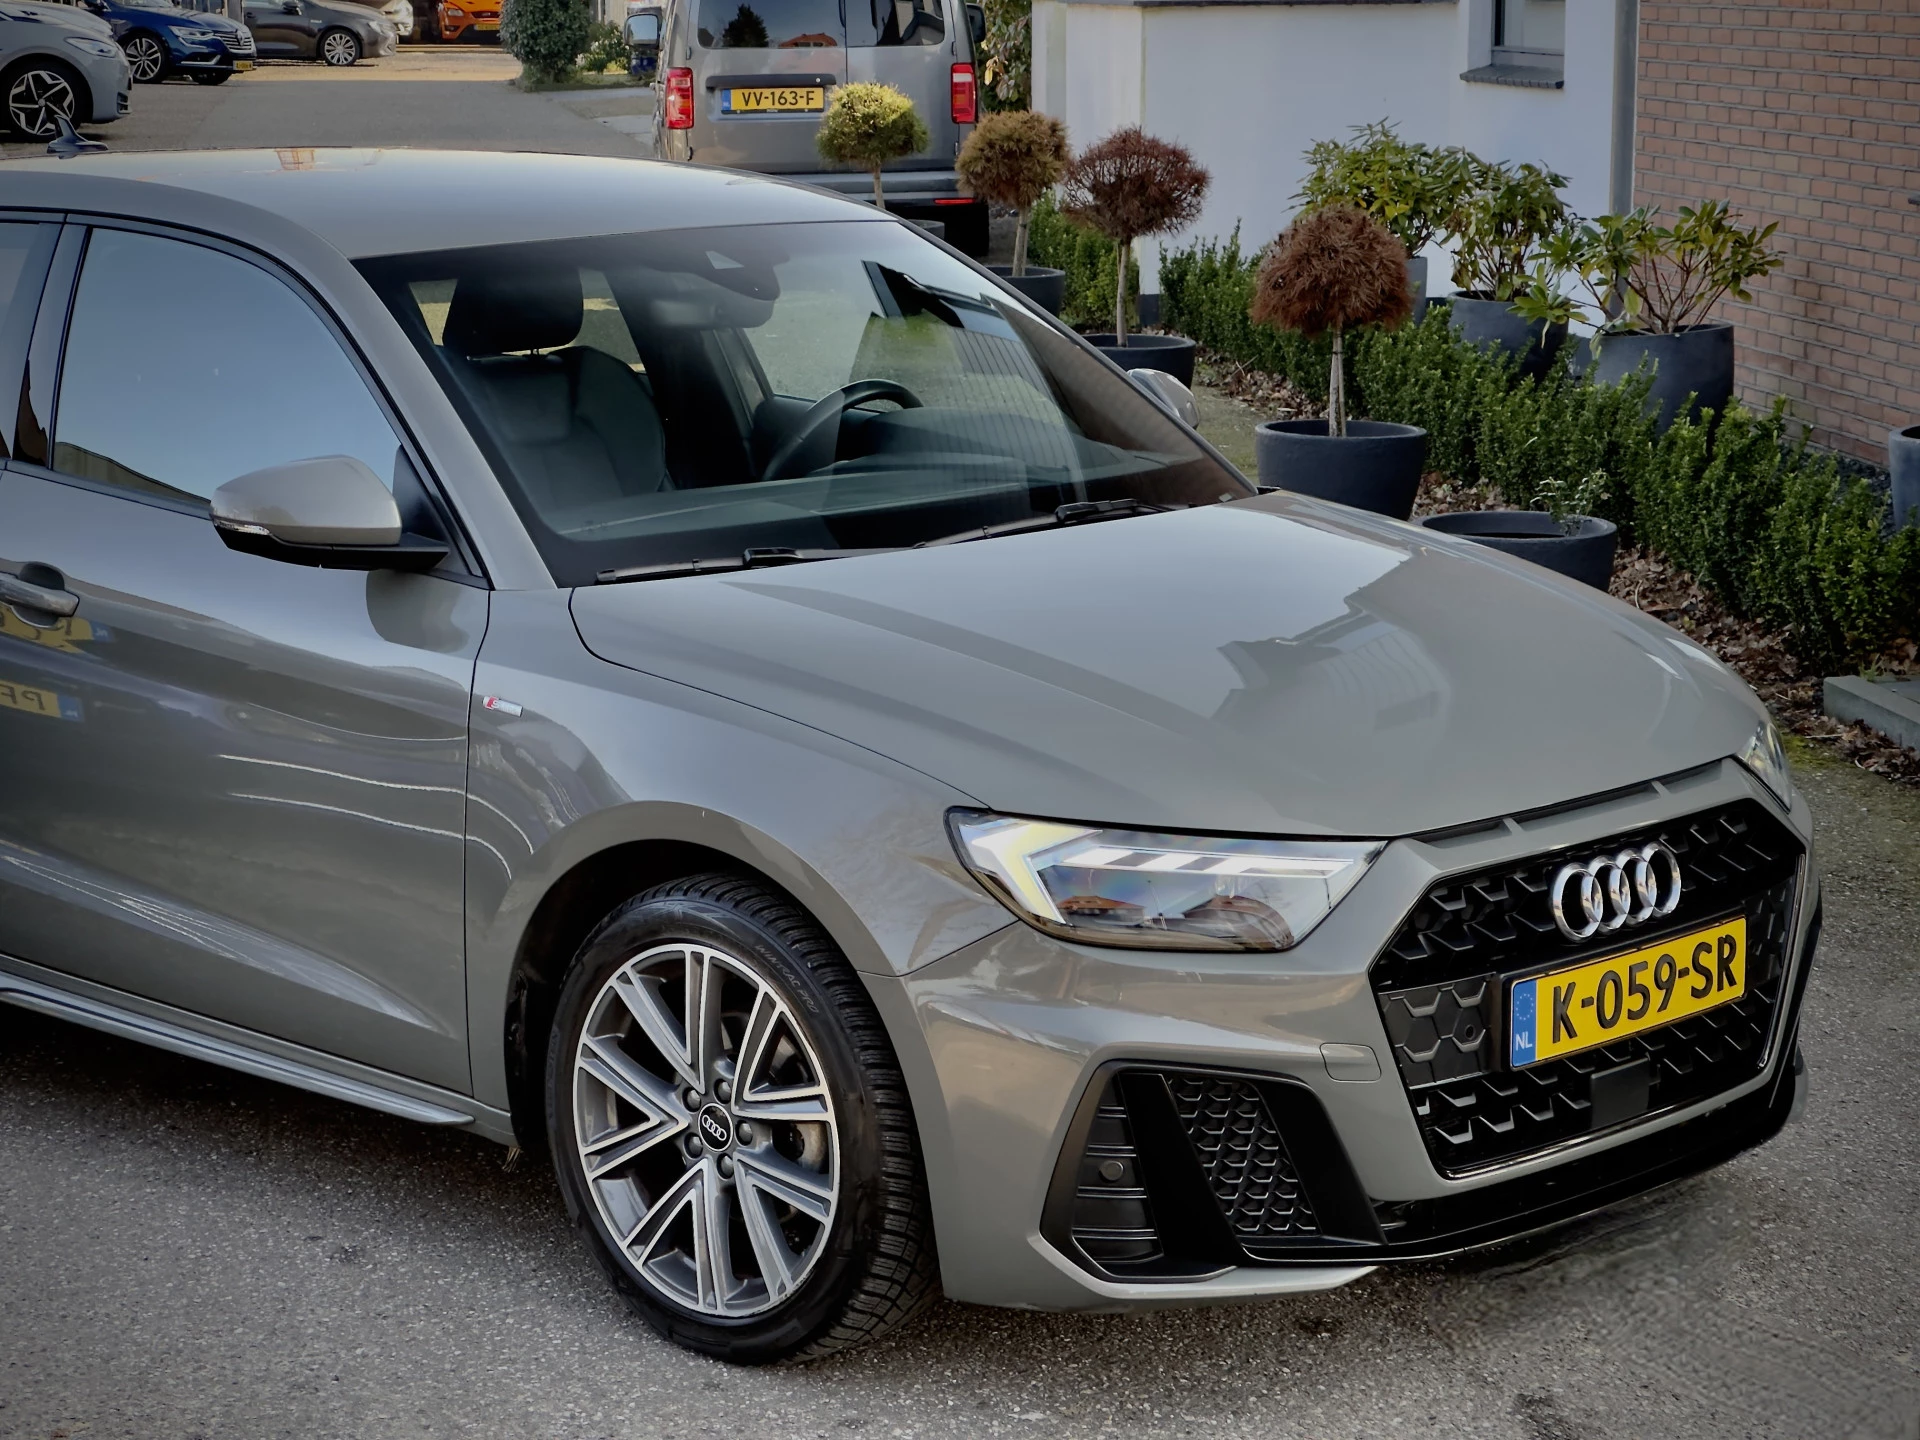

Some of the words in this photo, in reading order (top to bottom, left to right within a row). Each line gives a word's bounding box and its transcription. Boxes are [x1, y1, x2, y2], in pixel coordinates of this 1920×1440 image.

[741, 90, 815, 106] VV-163-F
[1552, 934, 1738, 1044] K-059-SR
[1515, 1031, 1533, 1051] NL
